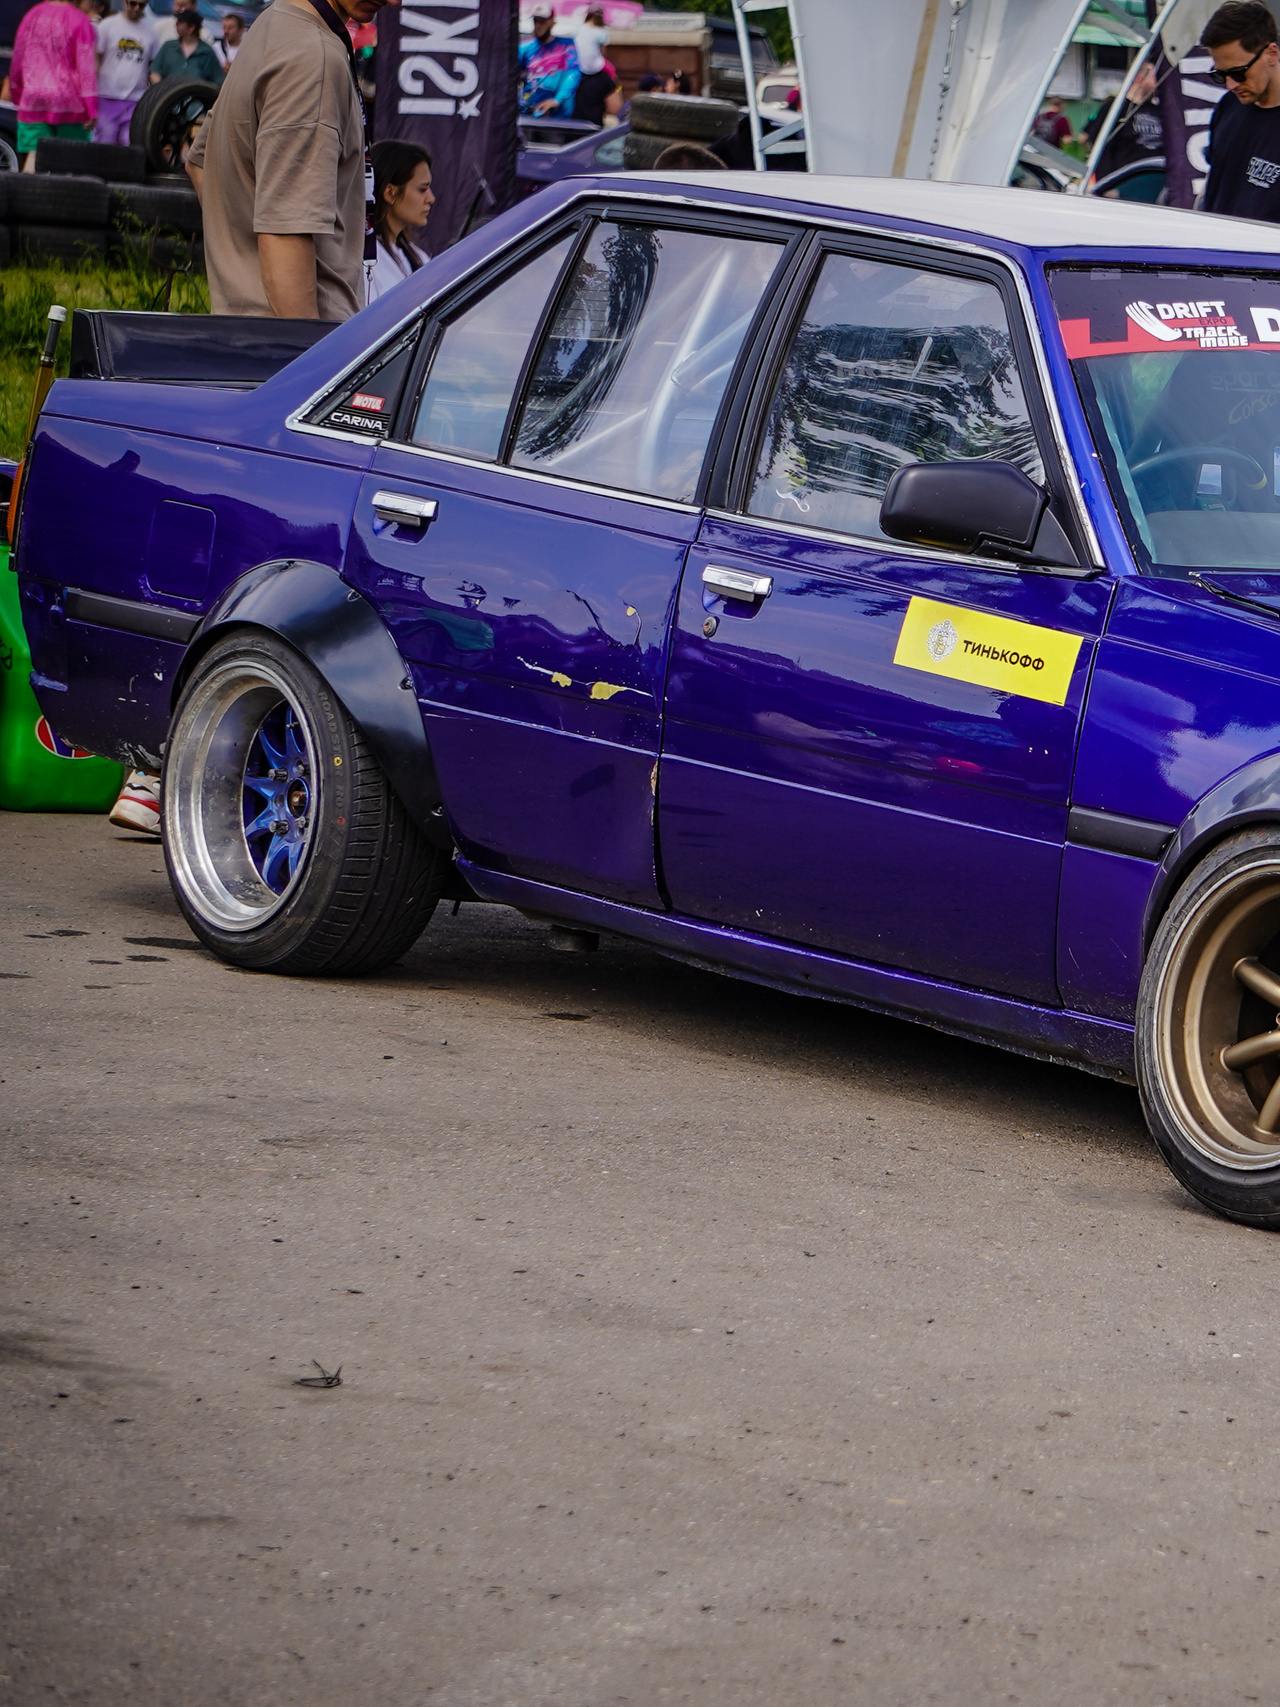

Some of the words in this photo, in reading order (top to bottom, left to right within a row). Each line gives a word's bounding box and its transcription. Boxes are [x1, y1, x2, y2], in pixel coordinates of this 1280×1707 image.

[1156, 300, 1226, 320] DRIFT
[1199, 318, 1228, 326] EXPO
[1183, 325, 1241, 338] TRACK
[1200, 335, 1249, 348] MODE
[354, 395, 383, 410] MOTUL
[331, 412, 383, 430] CARINA
[963, 640, 1045, 671] ТИНЬКОФФ
